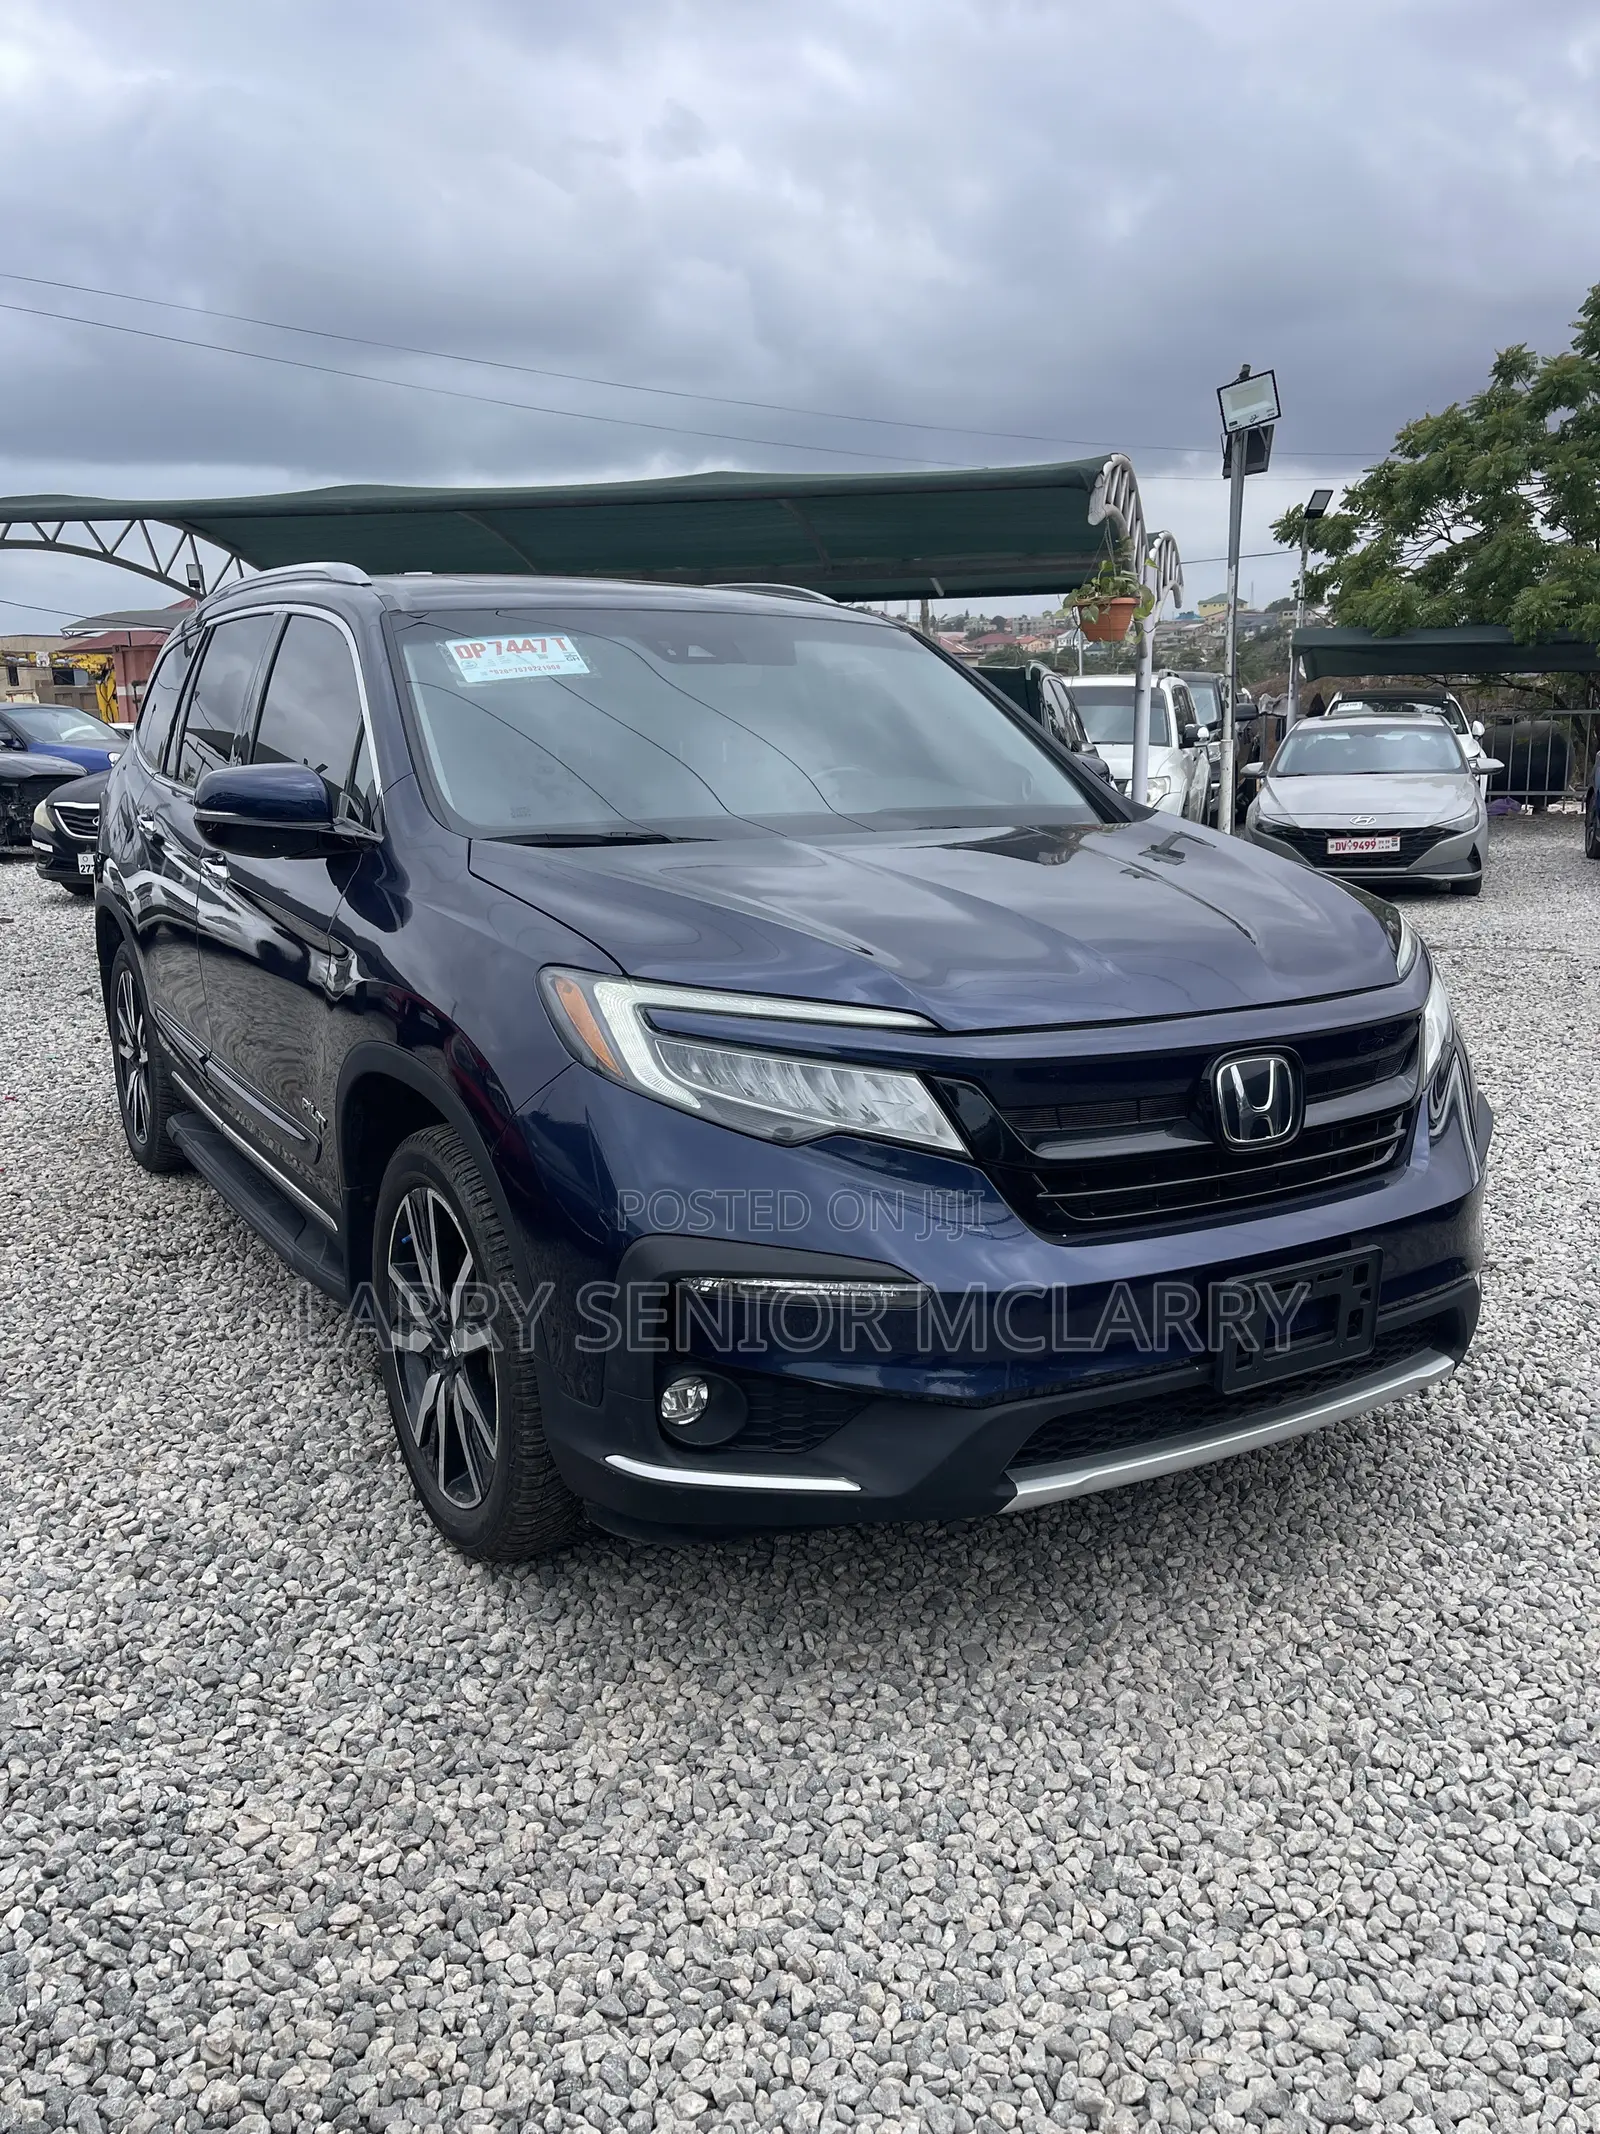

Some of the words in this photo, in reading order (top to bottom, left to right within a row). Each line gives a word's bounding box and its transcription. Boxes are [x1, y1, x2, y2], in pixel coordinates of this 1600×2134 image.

[454, 642, 487, 660] DP
[487, 638, 547, 656] 7447
[551, 637, 568, 652] T
[1335, 841, 1347, 851] DV
[1352, 840, 1376, 850] 9499
